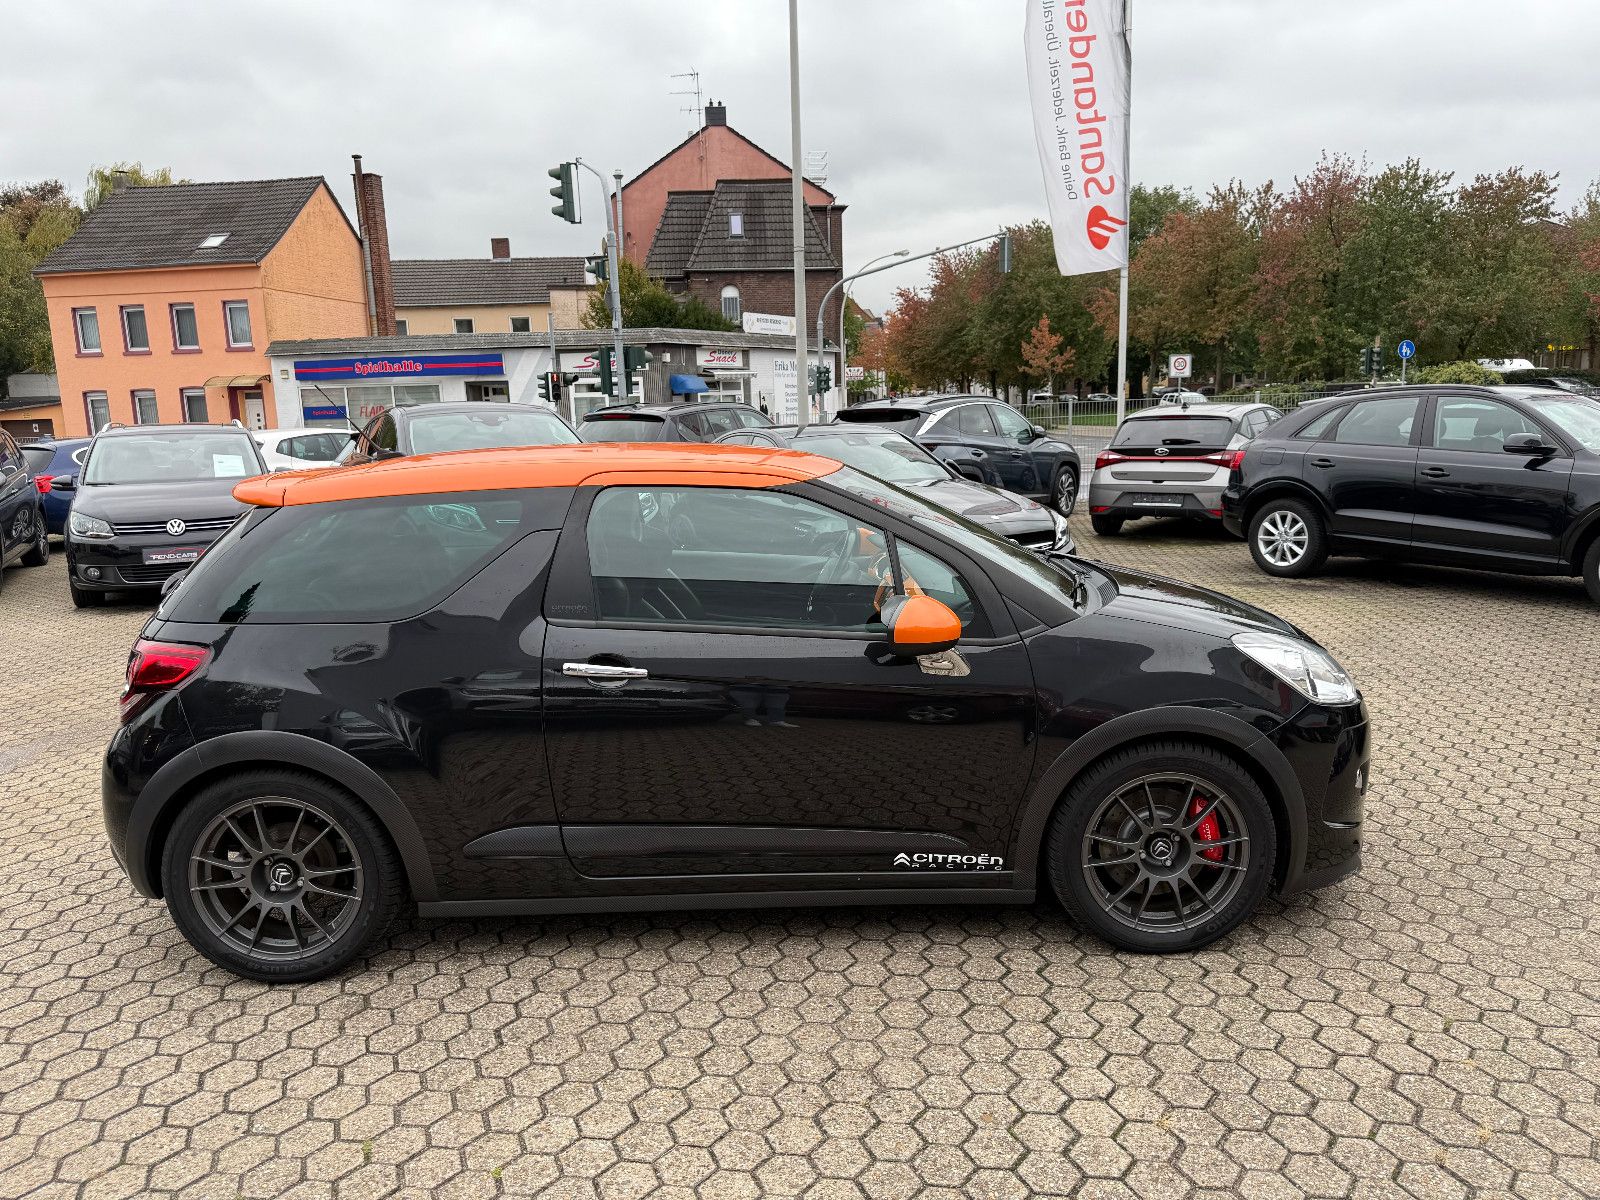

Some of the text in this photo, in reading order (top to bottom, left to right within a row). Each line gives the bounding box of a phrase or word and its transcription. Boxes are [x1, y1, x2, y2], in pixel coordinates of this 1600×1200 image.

[703, 350, 737, 363] Snack
[354, 360, 423, 375] Spielhalle
[911, 863, 1002, 871] RACING
